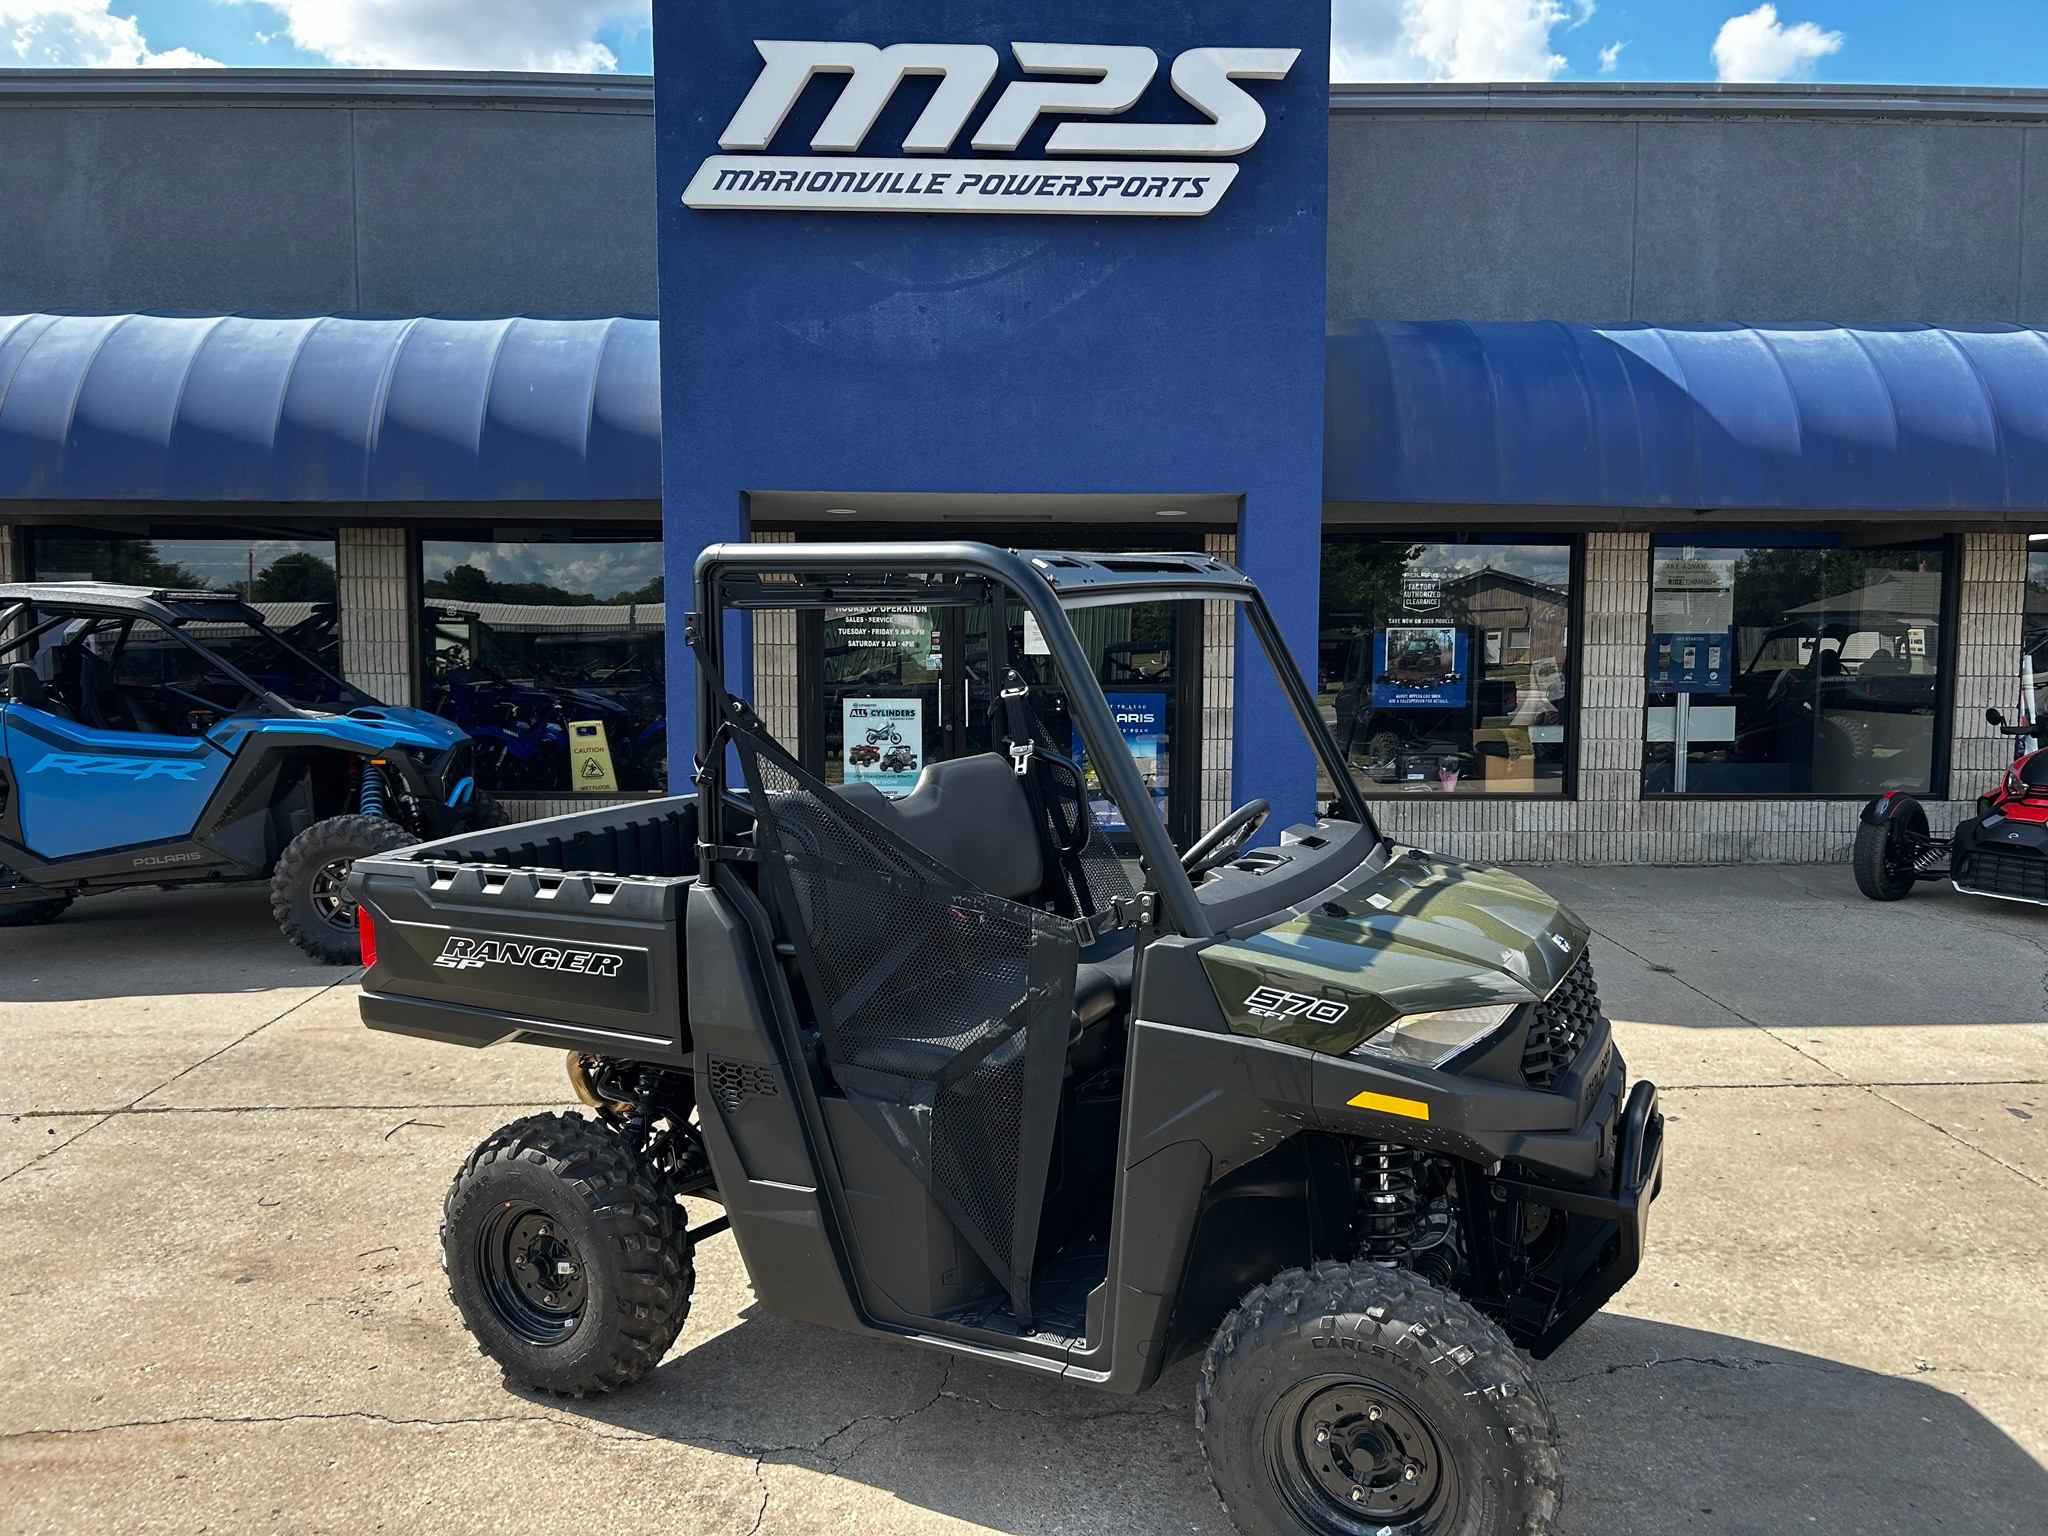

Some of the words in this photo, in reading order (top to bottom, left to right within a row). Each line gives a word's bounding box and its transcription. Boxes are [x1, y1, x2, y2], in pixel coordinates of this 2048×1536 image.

[717, 40, 1301, 156] MPS
[712, 169, 953, 195] MARIONVILLE
[956, 173, 1211, 199] POWERSPORTS
[1117, 714, 1154, 723] ARIS
[502, 728, 519, 738] YAMAHA
[26, 754, 206, 781] RZR
[133, 850, 201, 867] POLARIS
[432, 956, 486, 970] SP
[442, 936, 623, 978] RANGER
[1243, 985, 1349, 1024] 570
[1247, 1007, 1288, 1021] EFI
[1311, 1336, 1430, 1382] CARLSTAR
